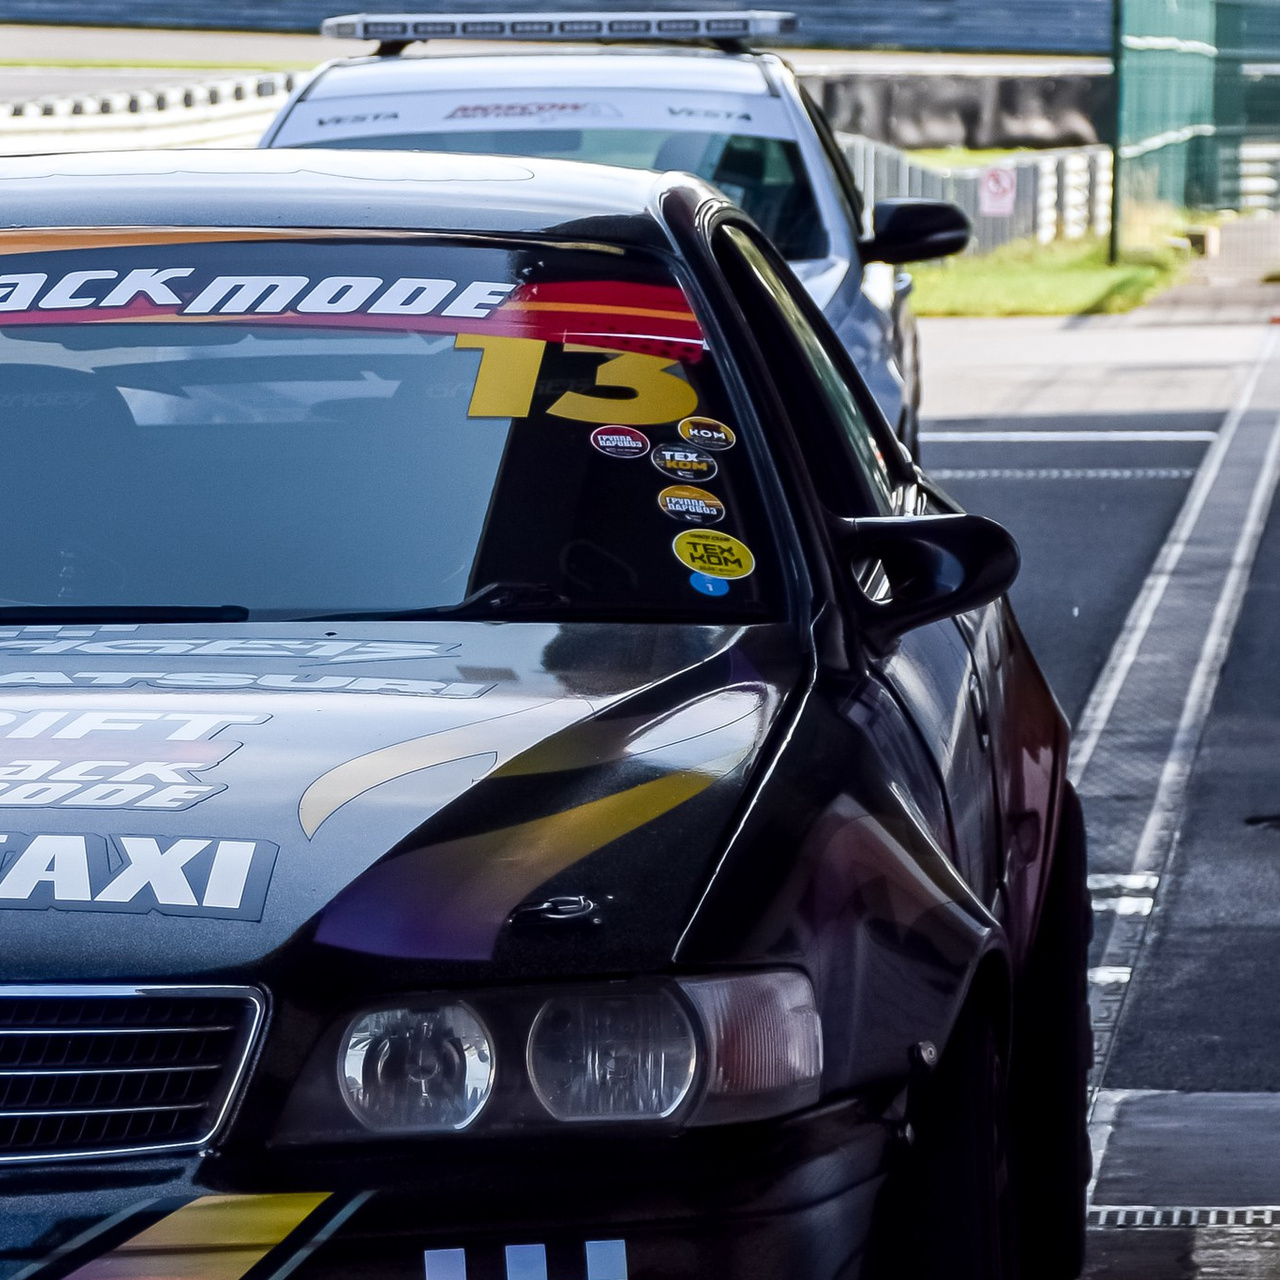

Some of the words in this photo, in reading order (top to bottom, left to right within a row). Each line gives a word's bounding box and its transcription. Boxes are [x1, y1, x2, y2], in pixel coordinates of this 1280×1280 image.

[317, 112, 400, 126] VESTA
[667, 106, 753, 122] VESTA
[453, 333, 699, 426] 13
